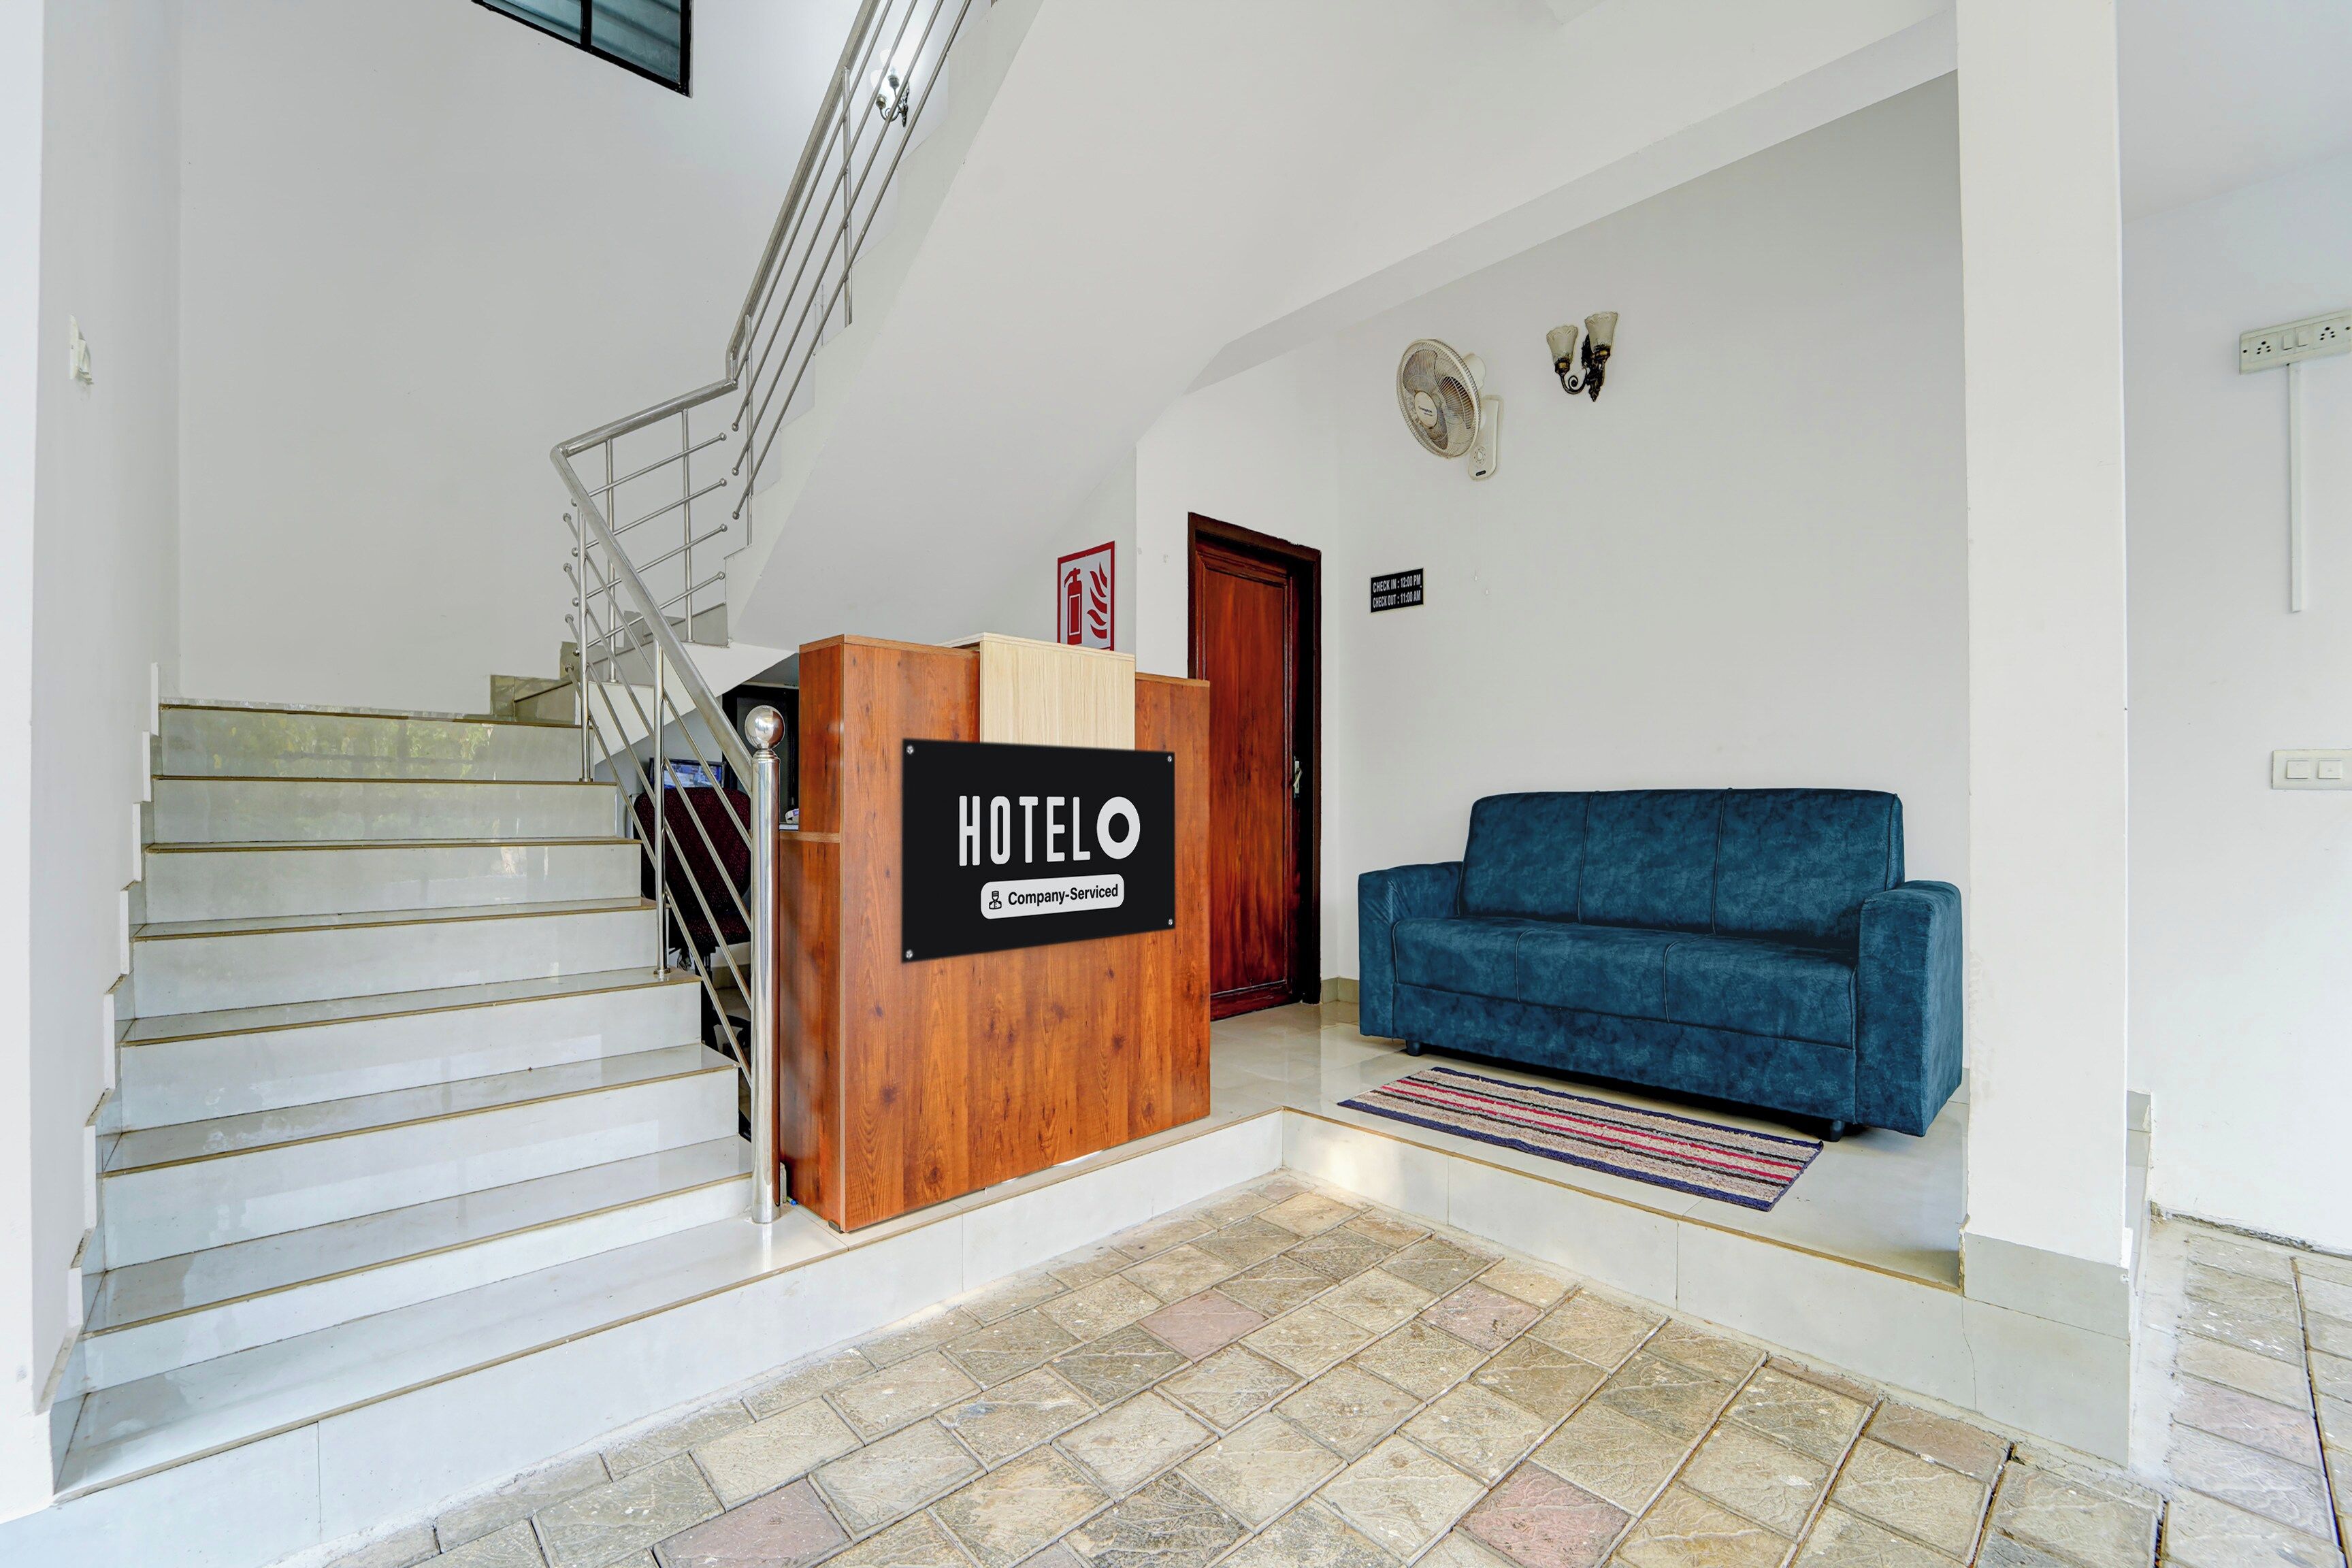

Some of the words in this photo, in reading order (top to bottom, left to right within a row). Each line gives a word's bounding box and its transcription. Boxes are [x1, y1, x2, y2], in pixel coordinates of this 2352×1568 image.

[1373, 580, 1390, 593] CHECK
[1391, 579, 1396, 590] IN
[1401, 576, 1413, 588] 12:00
[1414, 574, 1421, 585] PM
[1373, 595, 1387, 608] CHECK
[1388, 594, 1396, 606] OUT
[1401, 592, 1413, 604] 11:00
[1414, 590, 1421, 602] AM
[1008, 884, 1118, 906] Company-Serviced
